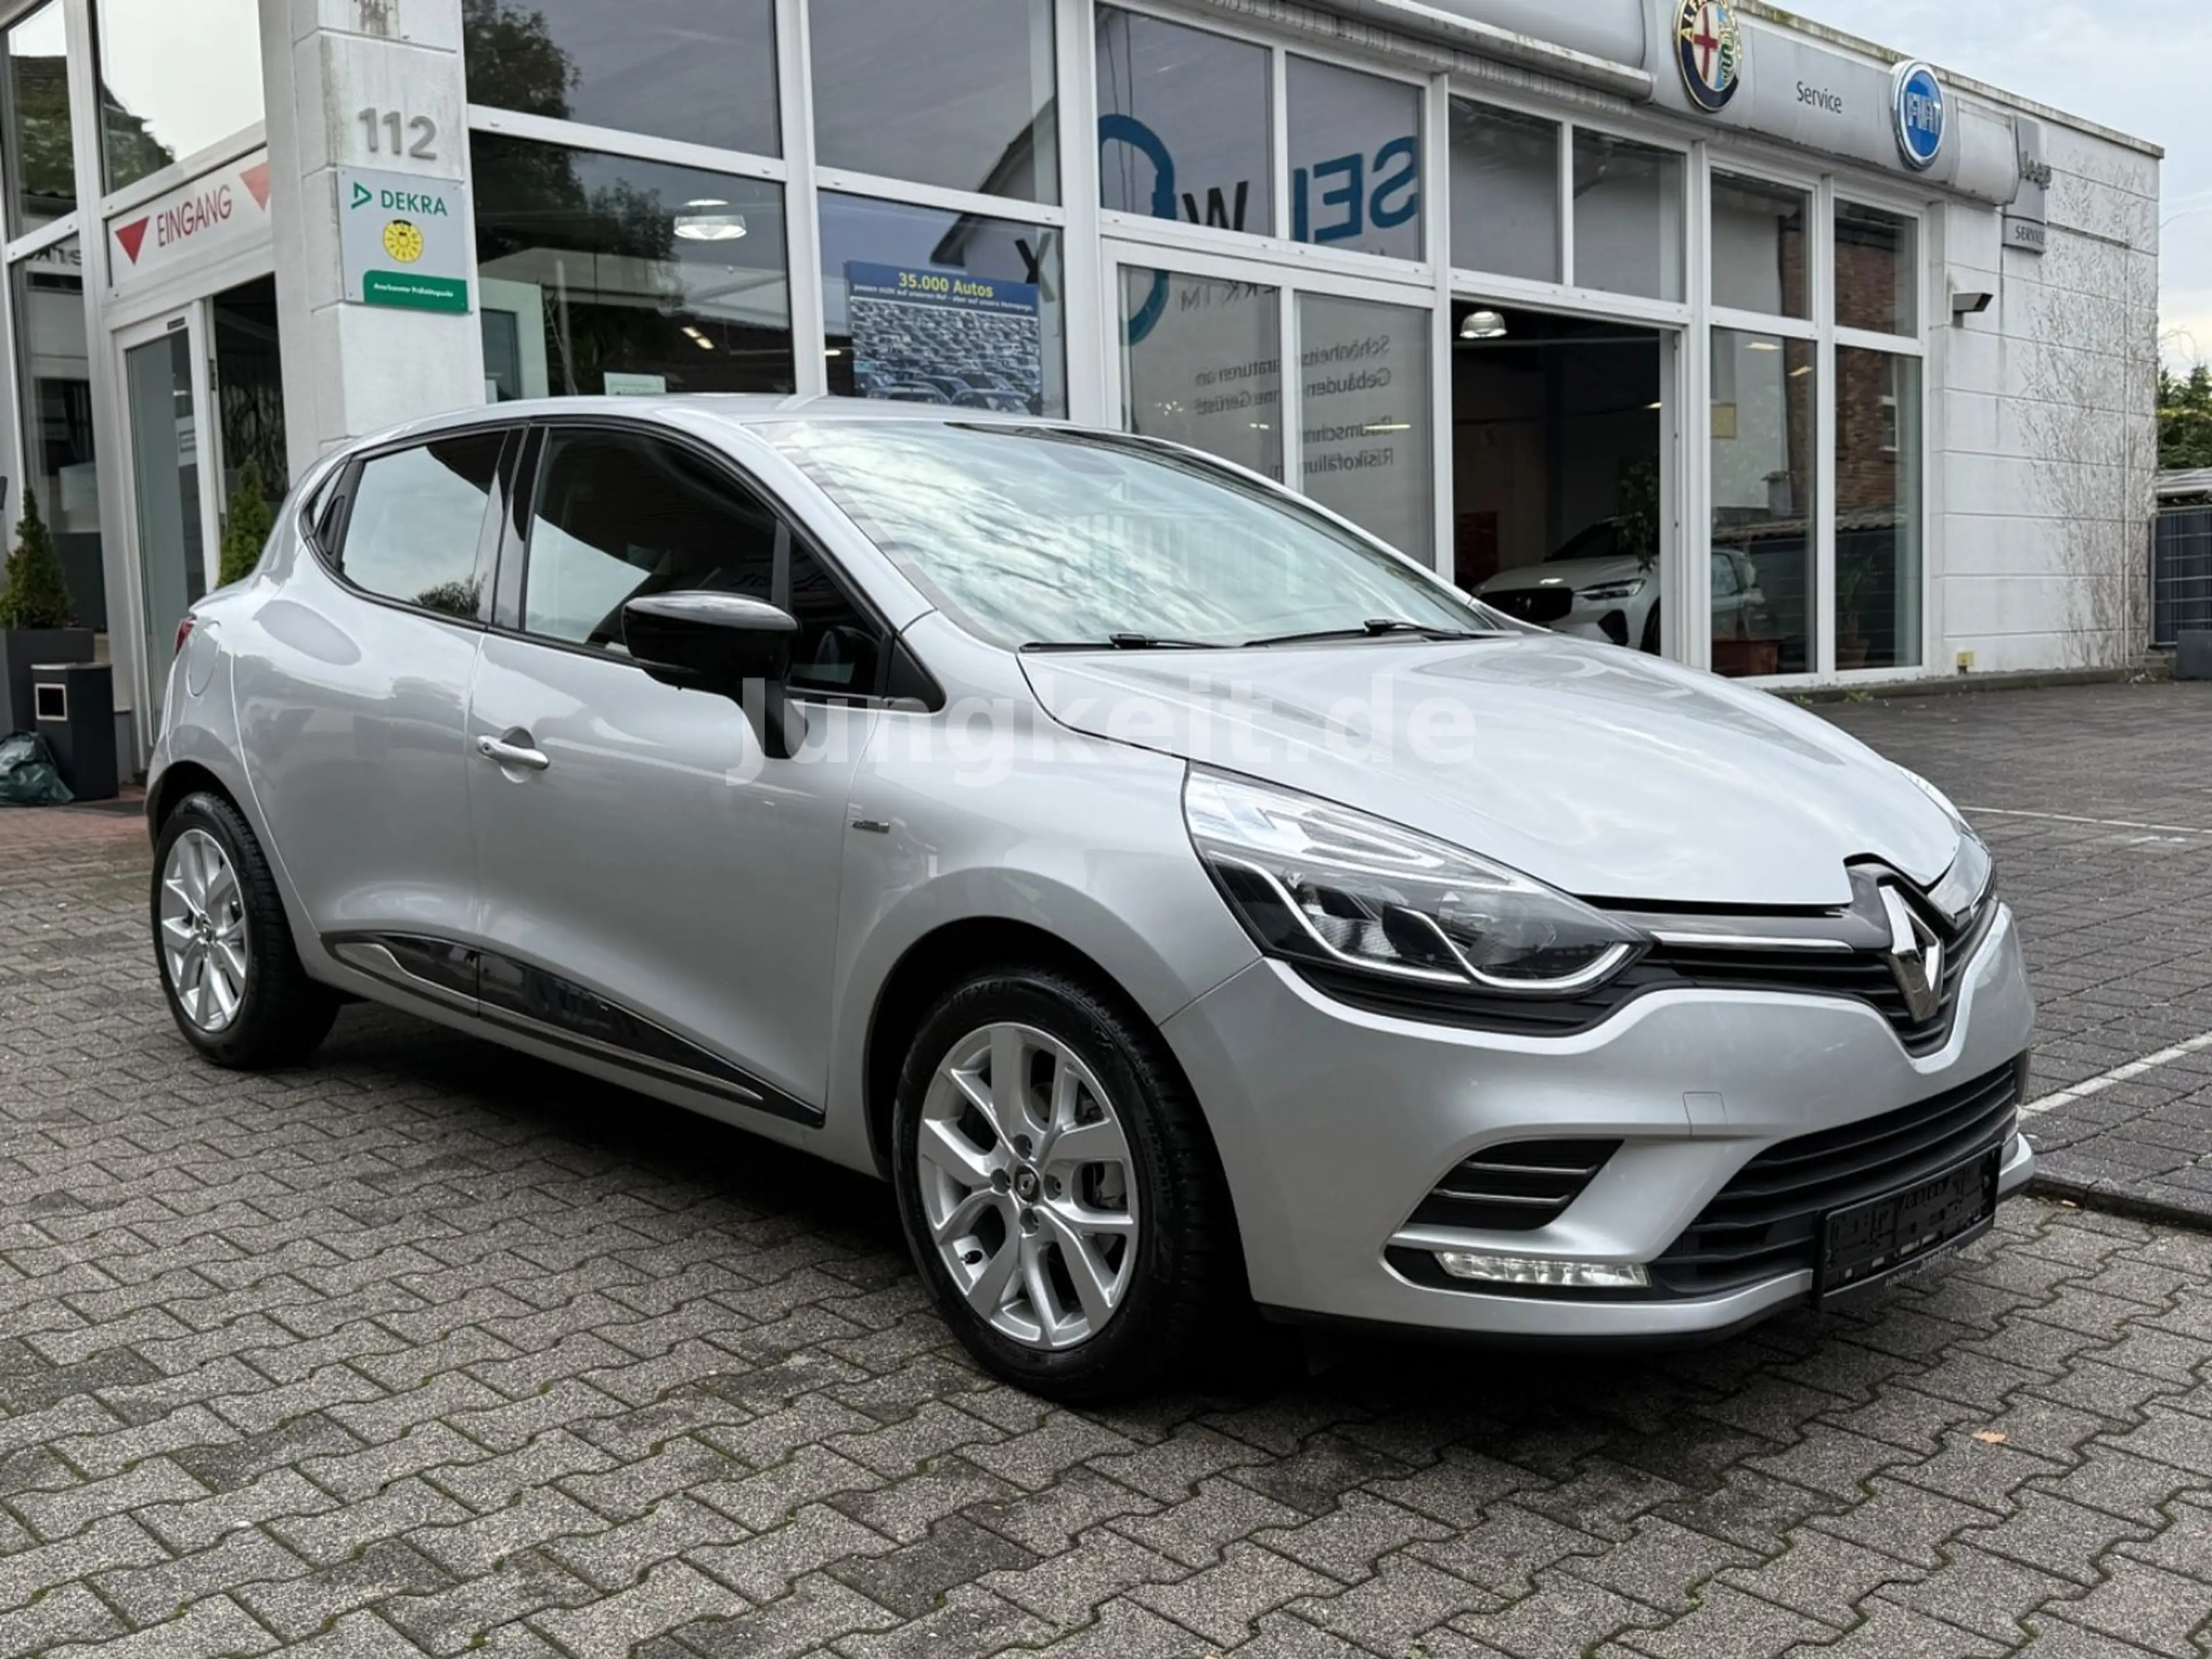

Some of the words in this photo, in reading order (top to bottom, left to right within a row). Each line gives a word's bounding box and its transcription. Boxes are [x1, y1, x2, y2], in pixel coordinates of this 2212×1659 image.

[1797, 80, 1843, 115] Service
[1907, 92, 1941, 137] FIAT
[358, 107, 438, 161] 112
[157, 184, 232, 248] EINGANG
[380, 189, 448, 216] DEKRA
[2015, 224, 2045, 246] SERVIC
[898, 271, 949, 293] 35.000
[953, 279, 994, 298] Autos
